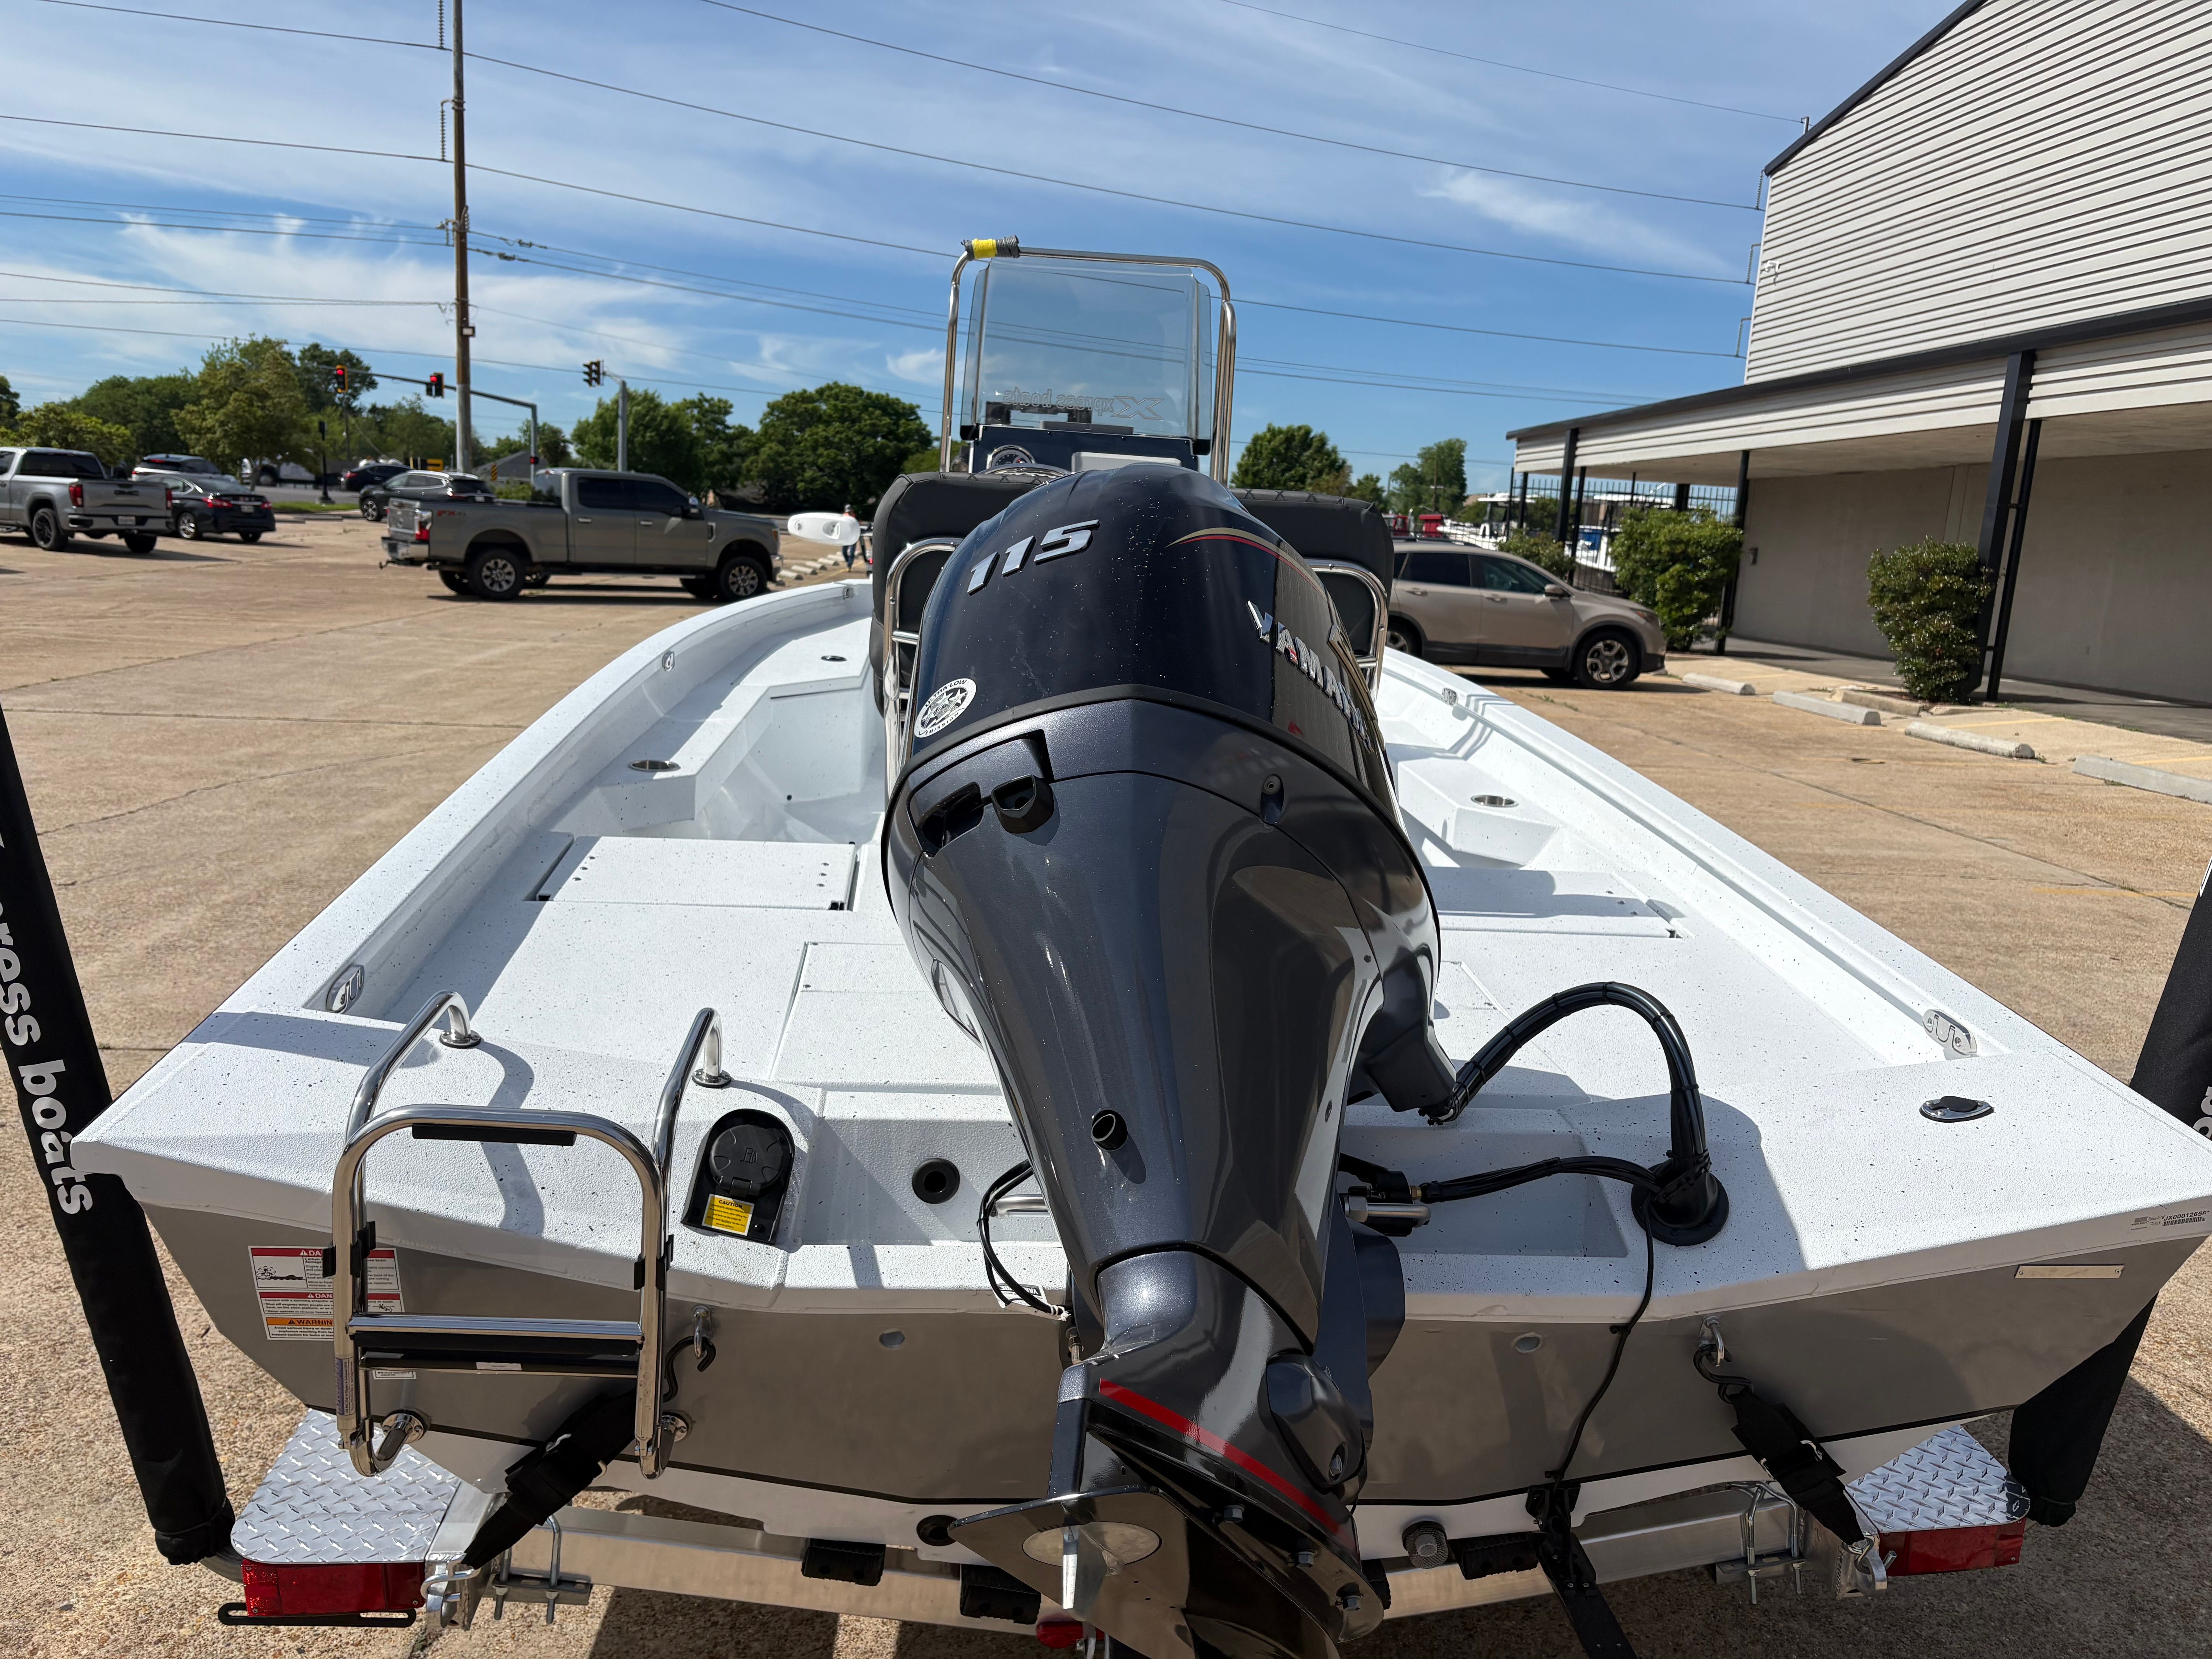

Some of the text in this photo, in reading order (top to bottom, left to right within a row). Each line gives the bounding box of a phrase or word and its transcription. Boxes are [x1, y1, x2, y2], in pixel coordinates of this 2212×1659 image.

[967, 519, 1100, 596] 115
[1246, 600, 1374, 754] YAMAHA
[925, 712, 959, 735] EMISSION
[18, 1059, 94, 1215] boats
[719, 1200, 743, 1208] CAUTION
